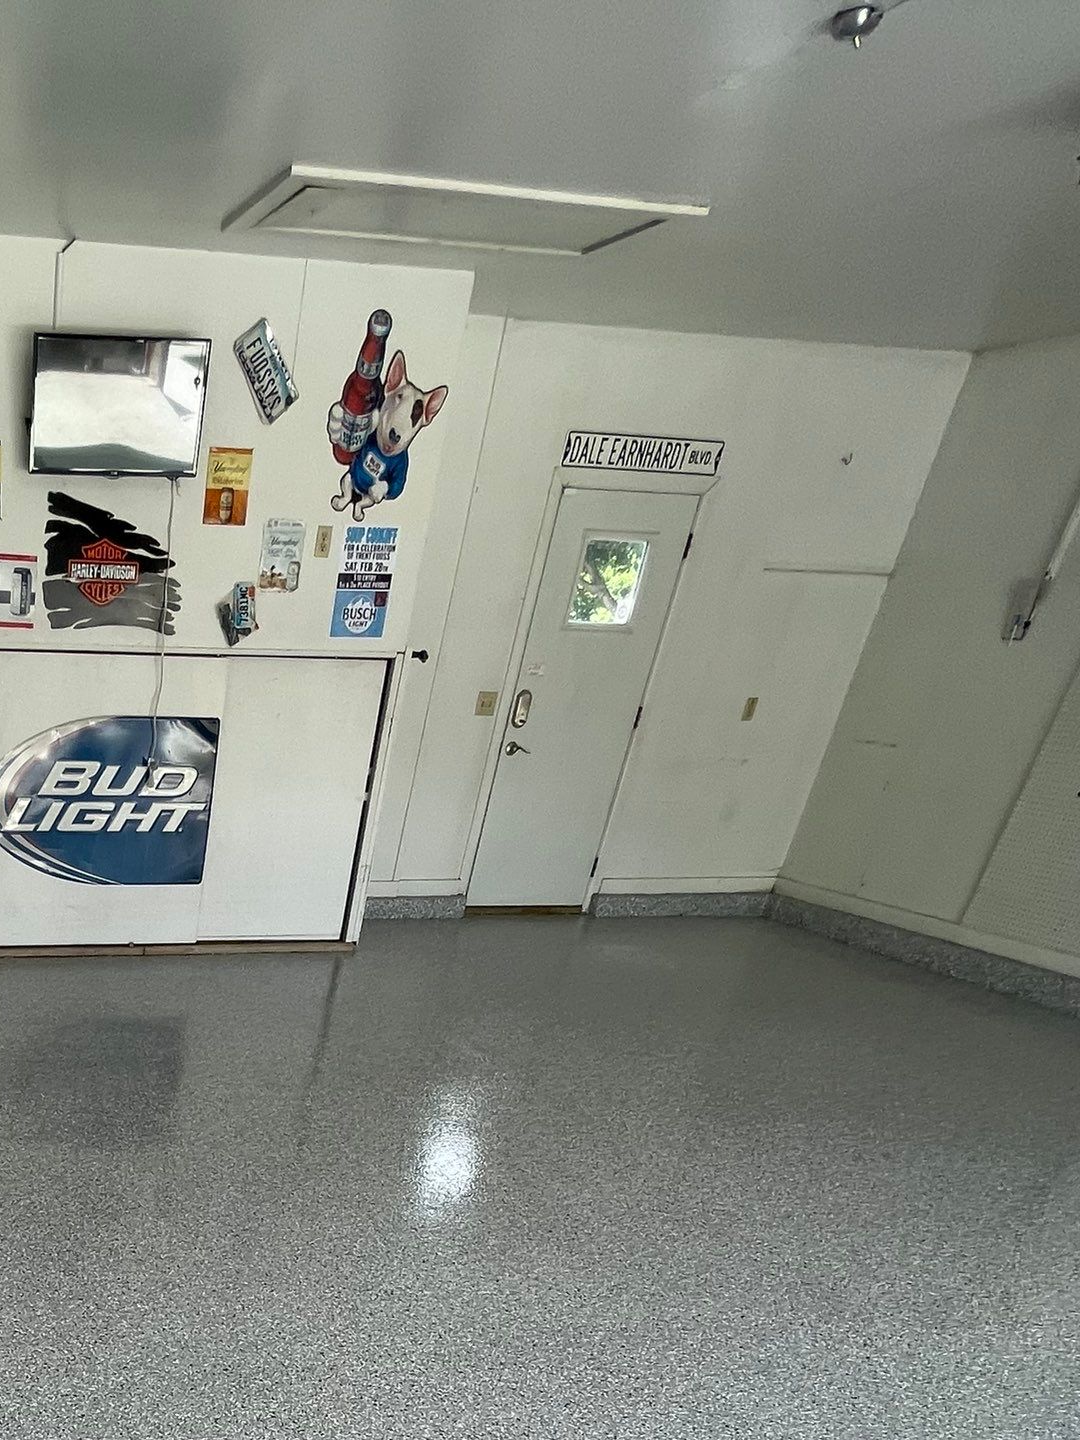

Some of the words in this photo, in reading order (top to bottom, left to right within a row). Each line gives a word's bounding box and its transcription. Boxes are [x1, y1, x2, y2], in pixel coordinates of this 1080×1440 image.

[570, 435, 609, 465] DALE
[607, 438, 691, 470] EARNHARDT
[87, 543, 122, 560] MOTOR
[70, 562, 137, 581] HARLEY-DAVIDSON
[359, 562, 373, 572] FEB
[85, 582, 121, 601] CYCLES
[342, 607, 377, 621] BUSCH
[348, 620, 368, 628] LIGHT
[37, 760, 199, 797] BUD
[0, 797, 208, 833] LIGHT
